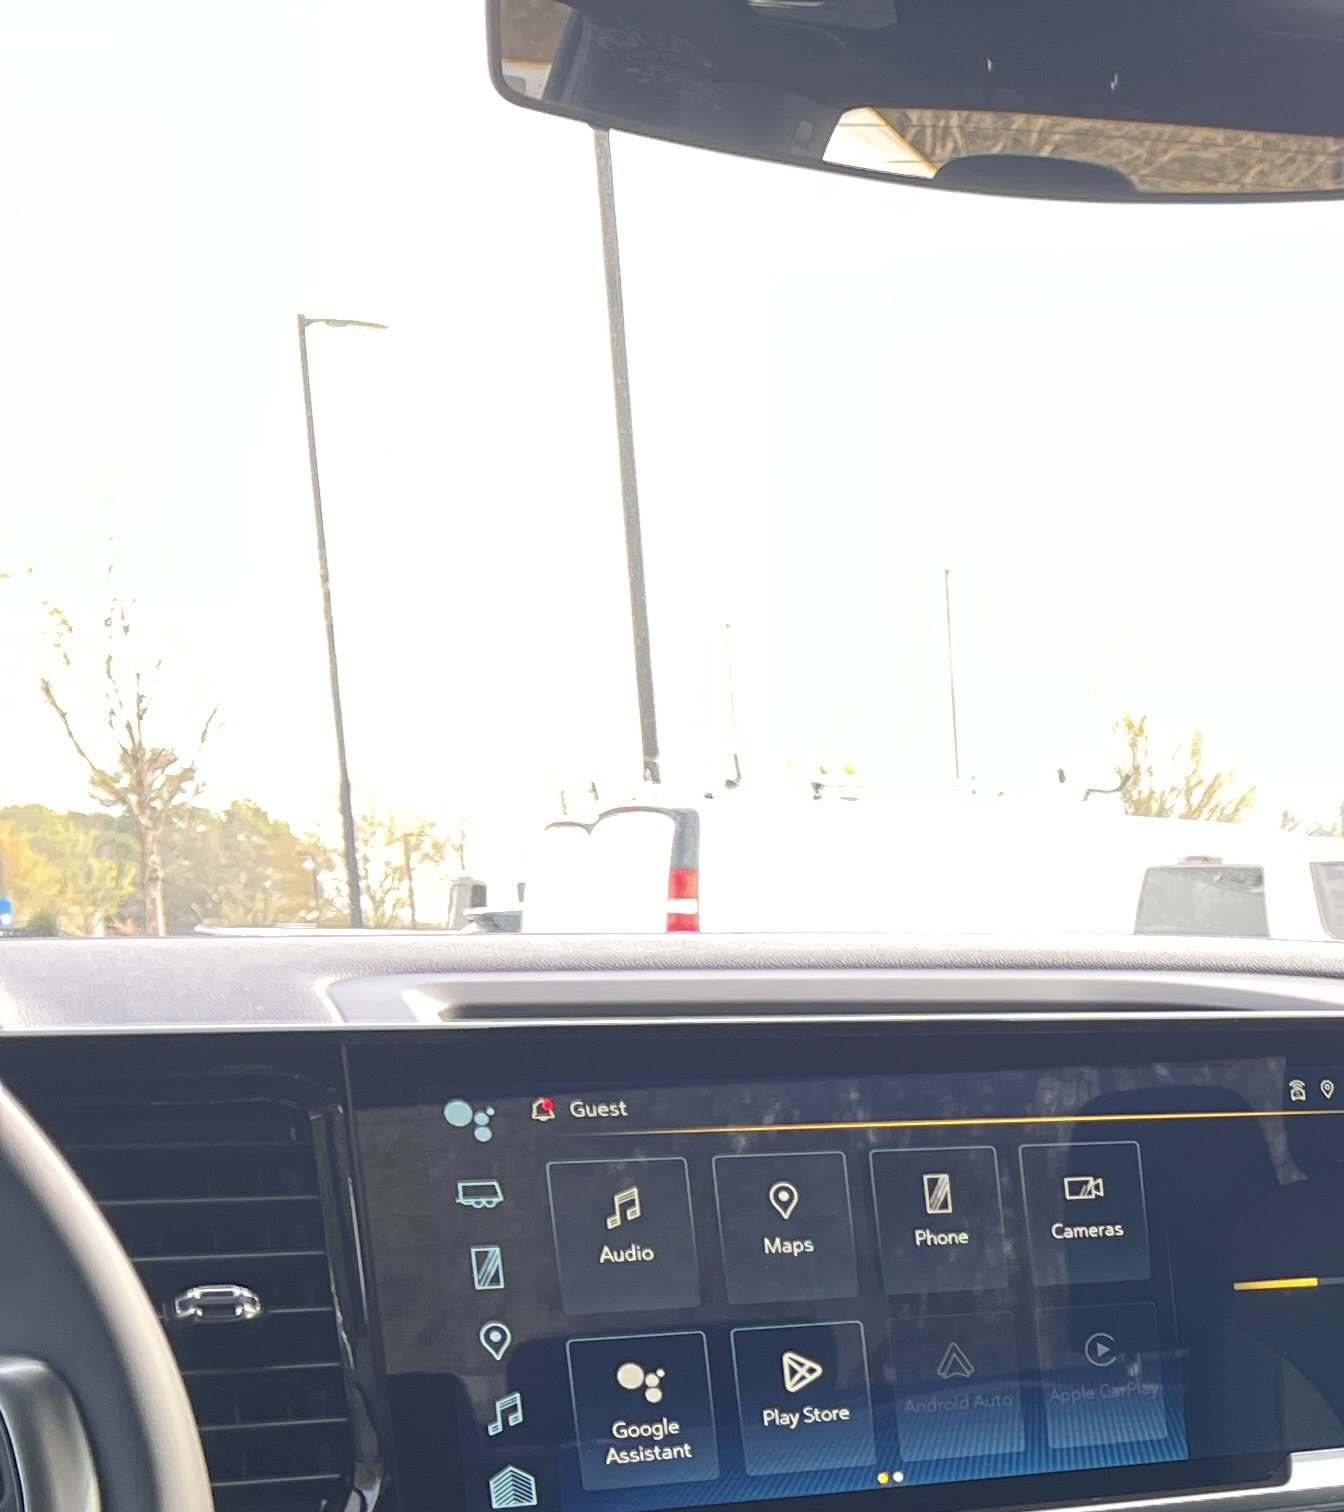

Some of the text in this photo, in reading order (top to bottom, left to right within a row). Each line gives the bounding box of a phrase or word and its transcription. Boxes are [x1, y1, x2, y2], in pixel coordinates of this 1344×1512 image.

[569, 1100, 629, 1119] Guest
[914, 1228, 969, 1247] Phone
[1051, 1222, 1125, 1240] Cameras
[599, 1244, 655, 1264] Audio
[763, 1236, 815, 1257] Maps
[762, 1404, 851, 1429] Play Store
[611, 1418, 681, 1442] Google
[605, 1443, 693, 1465] Assistant
